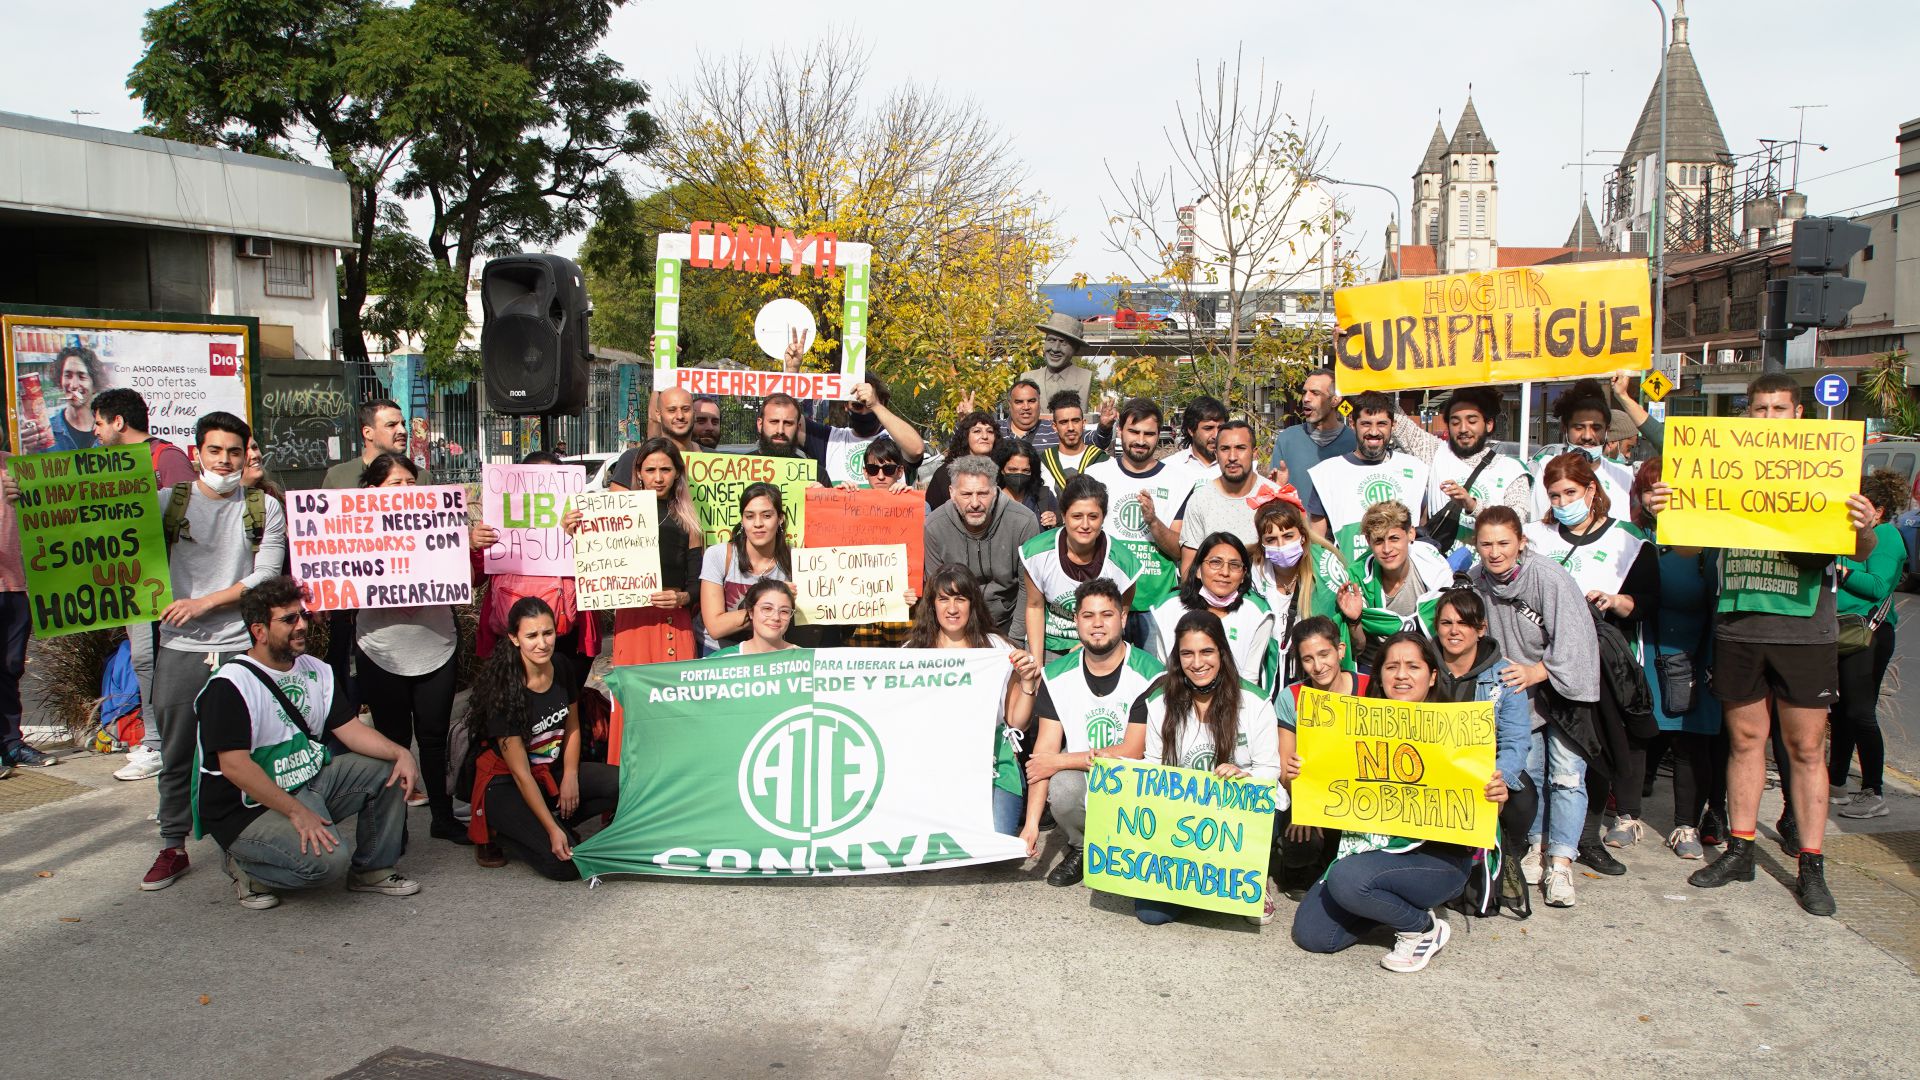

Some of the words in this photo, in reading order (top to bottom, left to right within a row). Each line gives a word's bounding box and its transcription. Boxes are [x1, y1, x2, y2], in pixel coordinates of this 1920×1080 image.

[690, 220, 837, 279] CDNNYA
[1423, 269, 1551, 314] HOGAR
[654, 258, 681, 370] ACA
[843, 263, 869, 374] HAY
[1337, 300, 1640, 371] CURAPALIGÜE
[114, 365, 131, 373] Con
[132, 365, 186, 374] AHORRAMES
[131, 376, 154, 387] 300
[157, 376, 197, 387] ofertas
[173, 389, 207, 401] precio
[677, 370, 841, 399] PRECARIZADES
[1824, 379, 1839, 401] E
[160, 400, 172, 417] el
[174, 405, 197, 417] mes
[1674, 425, 1696, 447] NO
[1700, 428, 1721, 448] AL
[1730, 428, 1855, 452] VACIAMIENTO
[14, 462, 36, 481] NO
[41, 456, 71, 479] HAY
[75, 448, 136, 476] MEDIAS
[786, 462, 816, 481] DEL
[1672, 458, 1683, 479] Y
[1692, 458, 1703, 479] A
[1711, 458, 1743, 480] LOS
[1755, 459, 1843, 480] DESPIDOS
[20, 488, 42, 509] NO
[45, 483, 77, 505] HAY
[79, 477, 151, 501] FRAZADAS
[489, 467, 583, 495] CONTRATO
[690, 482, 745, 503] CONSEJ
[295, 493, 329, 514] LOS
[341, 492, 437, 513] DERECHOS
[443, 491, 463, 509] DE
[576, 494, 614, 512] BASTA
[619, 494, 638, 509] DE
[1669, 487, 1697, 511] EN
[1706, 488, 1730, 511] EL
[1741, 489, 1827, 514] CONSEJO
[23, 508, 50, 531] NO
[51, 507, 79, 527] HAY
[79, 501, 145, 524] ESTUFAS
[295, 519, 317, 537] LA
[324, 515, 374, 535] NIÑEZ
[382, 510, 468, 532] NECESITAN
[574, 514, 633, 534] MENTIRAS
[637, 515, 646, 529] A
[700, 504, 738, 527] NIÑE
[294, 535, 416, 557] TRABAJADORXS
[425, 532, 460, 551] CON
[490, 527, 575, 561] BASUR
[576, 538, 602, 555] LXS
[92, 559, 141, 587] UN
[301, 558, 384, 579] DERECHOS
[577, 559, 612, 573] BASTA
[798, 555, 827, 573] LOS
[1762, 561, 1773, 574] DE
[303, 580, 360, 611] UBA
[366, 580, 469, 606] PRECARIZADO
[578, 572, 657, 594] PRECARIZACIÓN
[584, 596, 600, 609] EN
[603, 594, 616, 607] EL
[842, 597, 888, 617] COBRAR
[680, 664, 751, 682] FORTALECER
[754, 663, 766, 678] EL
[769, 659, 811, 676] ESTADO
[814, 660, 843, 671] PARA
[846, 658, 897, 671] LIBERAR
[899, 658, 916, 670] LA
[918, 657, 966, 669] NACION
[649, 682, 781, 704] AGRUPACION
[787, 676, 857, 695] VERDE
[864, 675, 880, 691] Y
[884, 671, 973, 688] BLANCA
[1299, 691, 1335, 727] LXS
[1340, 695, 1496, 747] TRABAJADXRES
[753, 716, 866, 829] ATE
[1355, 740, 1425, 783] NO
[1088, 763, 1125, 795] LXS
[1133, 768, 1276, 814] TRABAJADXRES
[1324, 779, 1475, 830] SOBRAN
[1116, 806, 1156, 840] NO
[1171, 815, 1243, 852] SON
[1088, 843, 1262, 903] DESCARTABLES
